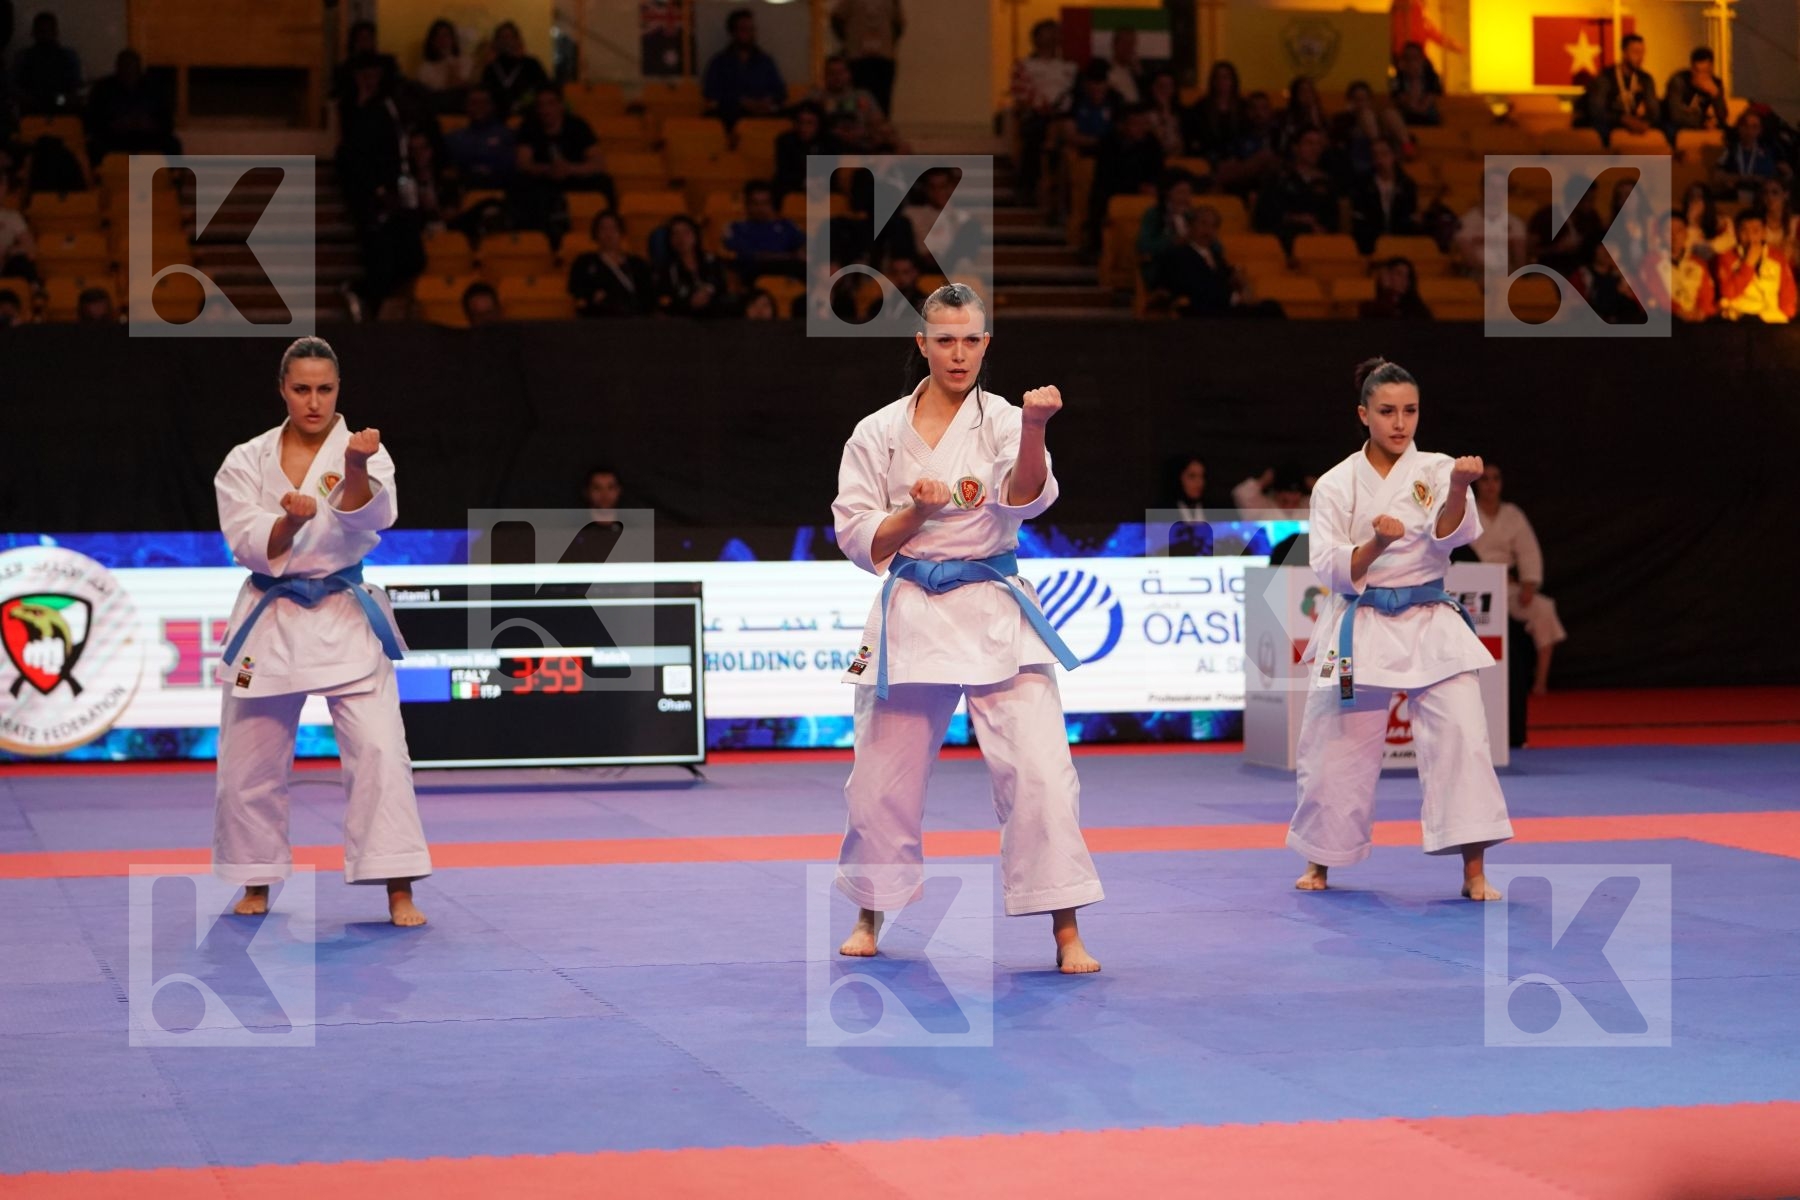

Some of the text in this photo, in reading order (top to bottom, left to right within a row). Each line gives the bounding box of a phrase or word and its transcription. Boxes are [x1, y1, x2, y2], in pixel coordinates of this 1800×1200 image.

[1143, 611, 1240, 646] OASI
[512, 655, 584, 694] 3:59
[704, 650, 807, 671] HOLDING
[451, 669, 491, 684] ITALY
